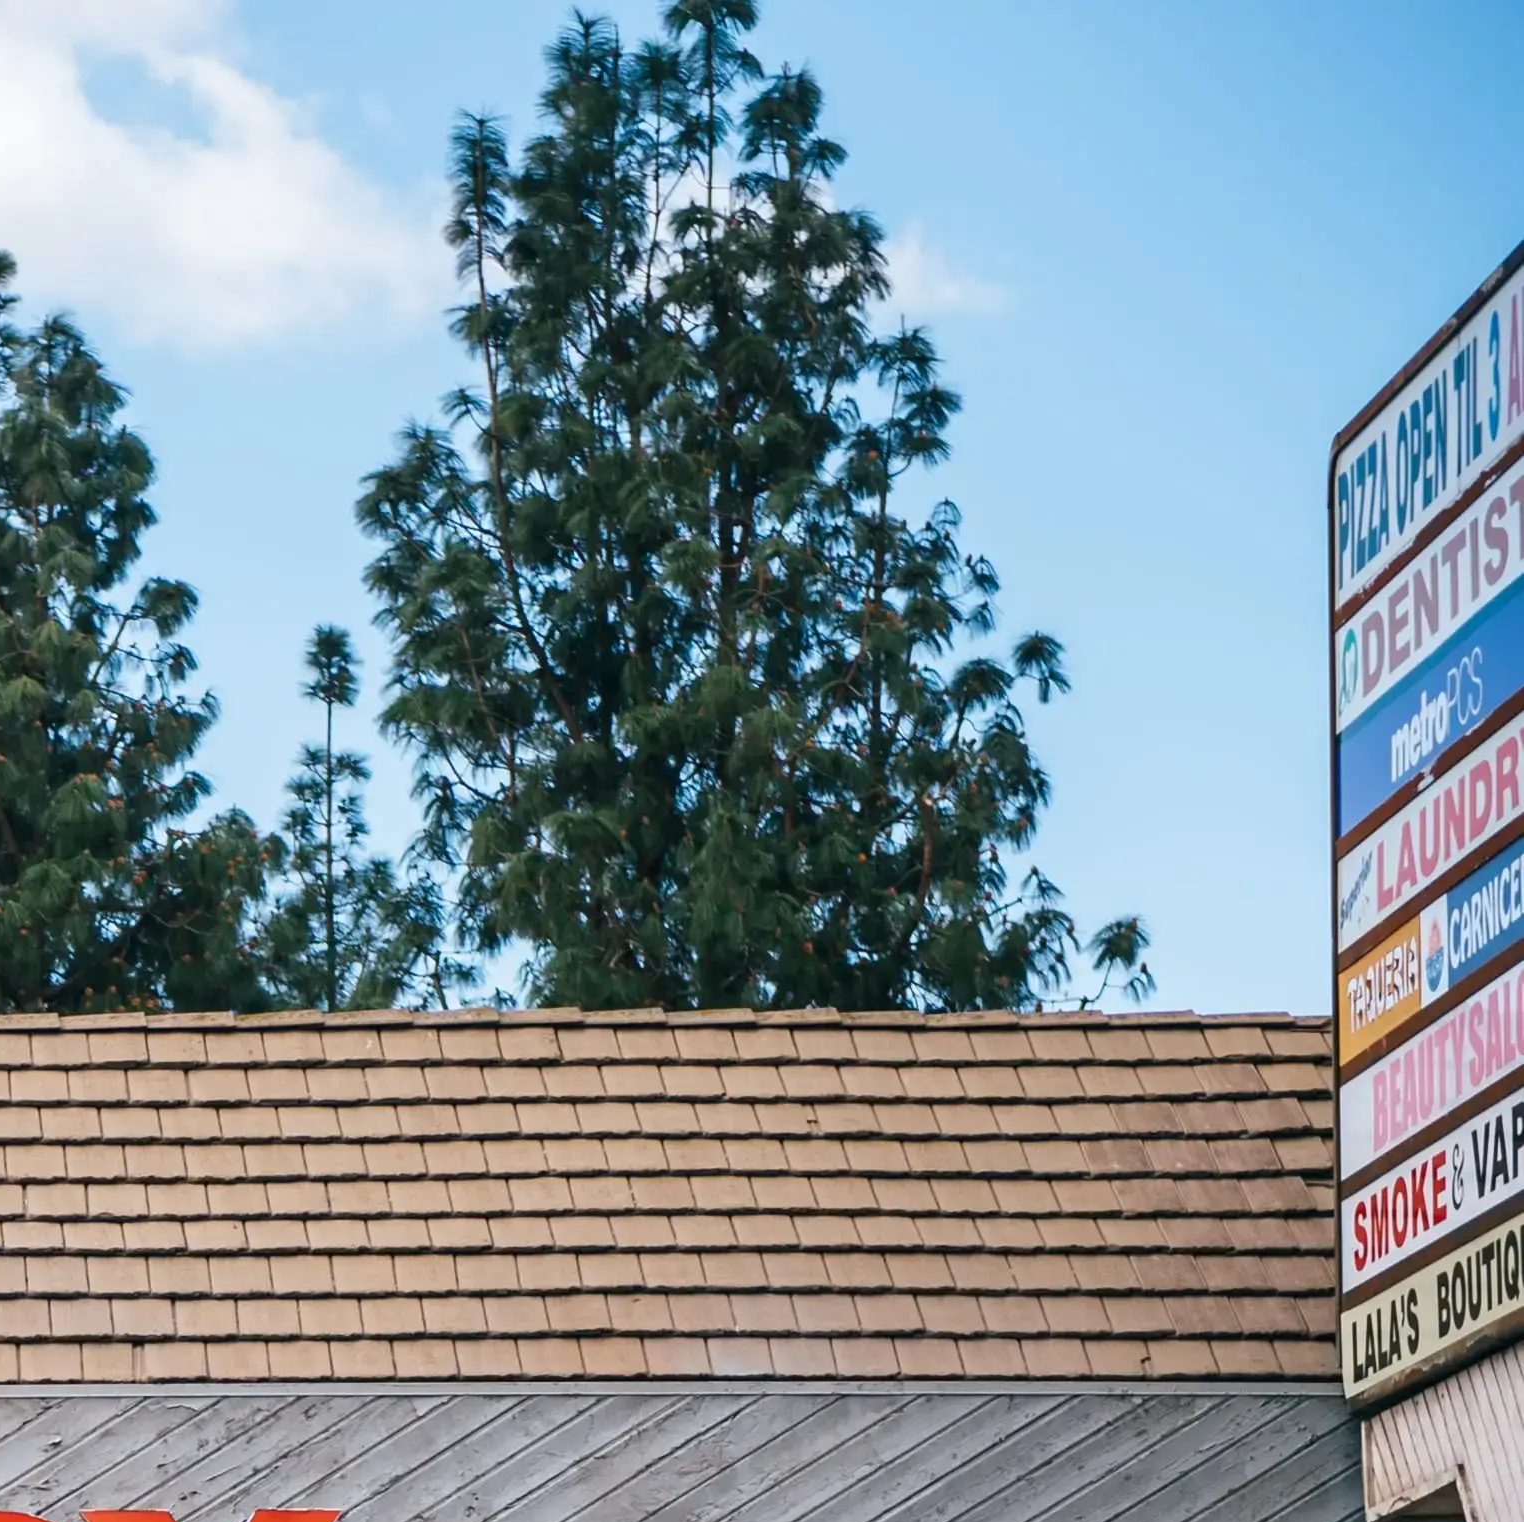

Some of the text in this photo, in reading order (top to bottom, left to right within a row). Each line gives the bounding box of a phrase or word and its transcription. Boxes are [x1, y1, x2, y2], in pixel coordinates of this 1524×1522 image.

[1338, 430, 1390, 590] PIZZA
[1396, 368, 1448, 537] OPEN
[1452, 336, 1483, 477] TIL
[1487, 308, 1501, 442] 3
[1390, 647, 1484, 783] metroPCS
[1347, 934, 1421, 1036] TAQUERIA
[1353, 1150, 1448, 1273] SMOKE
[1451, 1142, 1466, 1212] &
[1351, 1287, 1420, 1386] LALA'S
